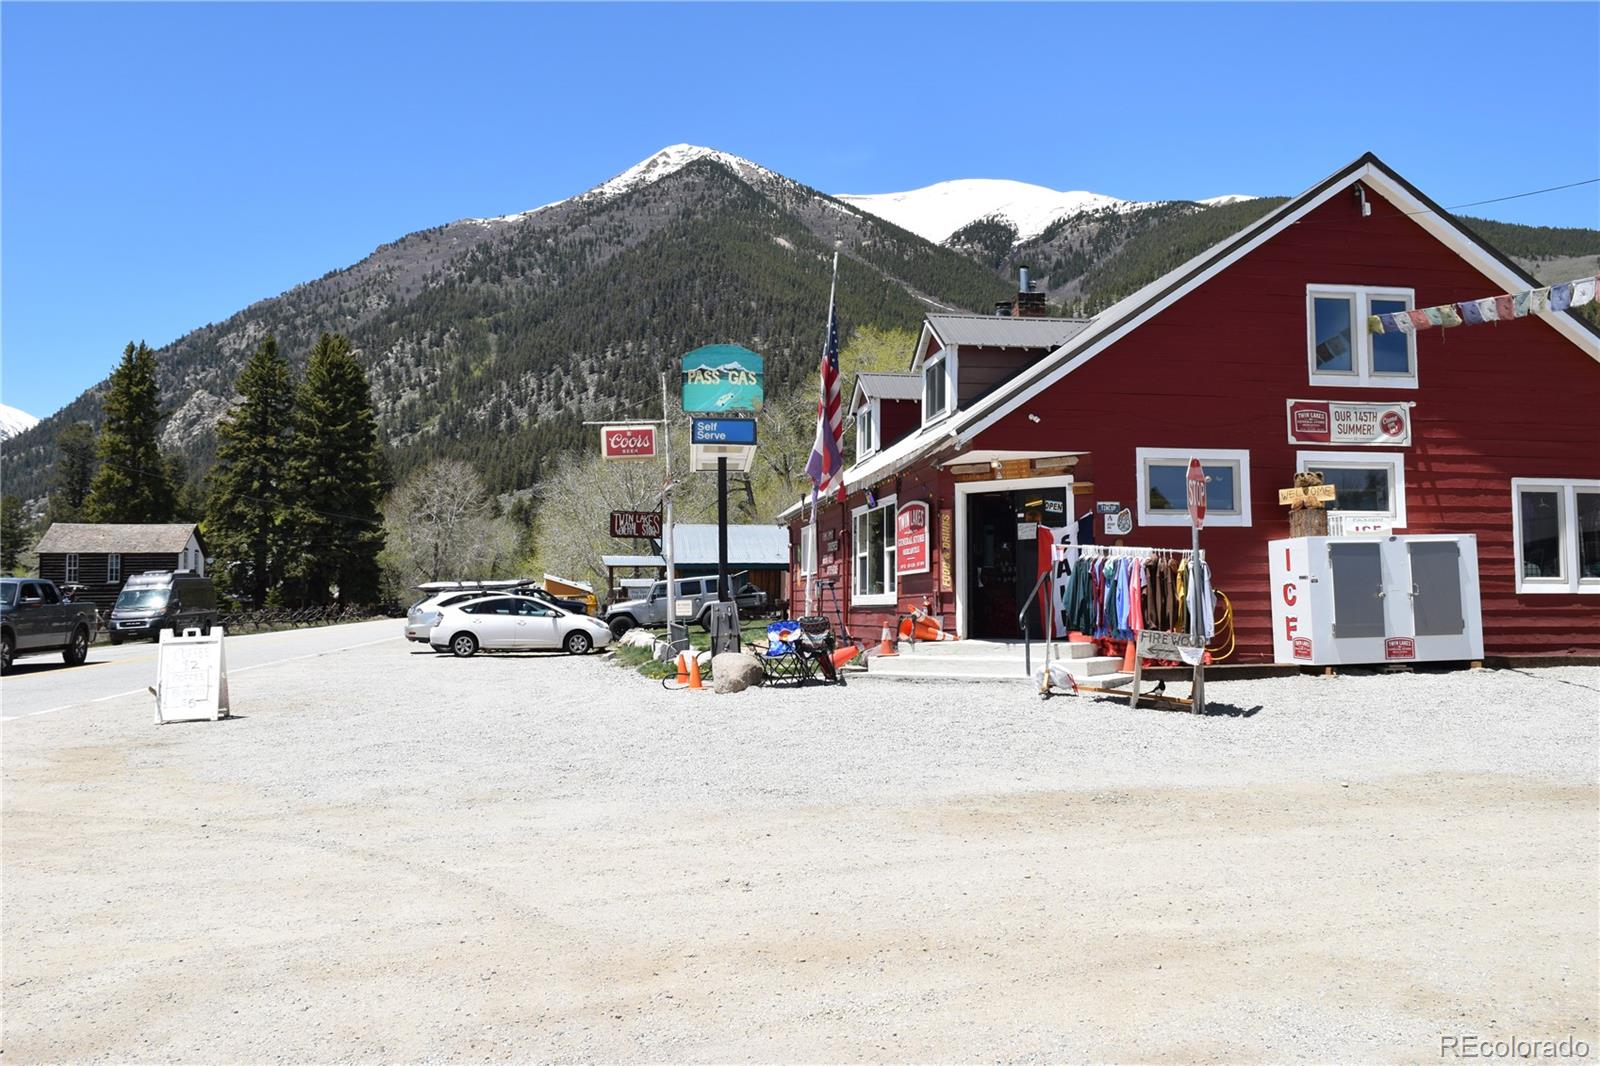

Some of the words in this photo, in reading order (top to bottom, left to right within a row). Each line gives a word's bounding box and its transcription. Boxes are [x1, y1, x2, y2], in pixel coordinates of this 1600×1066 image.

[687, 370, 720, 385] PASS
[728, 370, 757, 385] GAS
[1334, 410, 1352, 422] OUR
[1354, 410, 1378, 422] 145TH
[697, 422, 717, 431] Self
[1337, 424, 1375, 436] SUMMER!
[608, 433, 650, 449] Coors
[697, 431, 726, 440] Serve
[1188, 479, 1206, 507] STOP
[1281, 486, 1332, 501] WELOME
[1045, 502, 1063, 511] OPEN
[941, 513, 951, 549] DRINKS
[941, 562, 951, 587] FOOD
[1283, 548, 1298, 641] ICE
